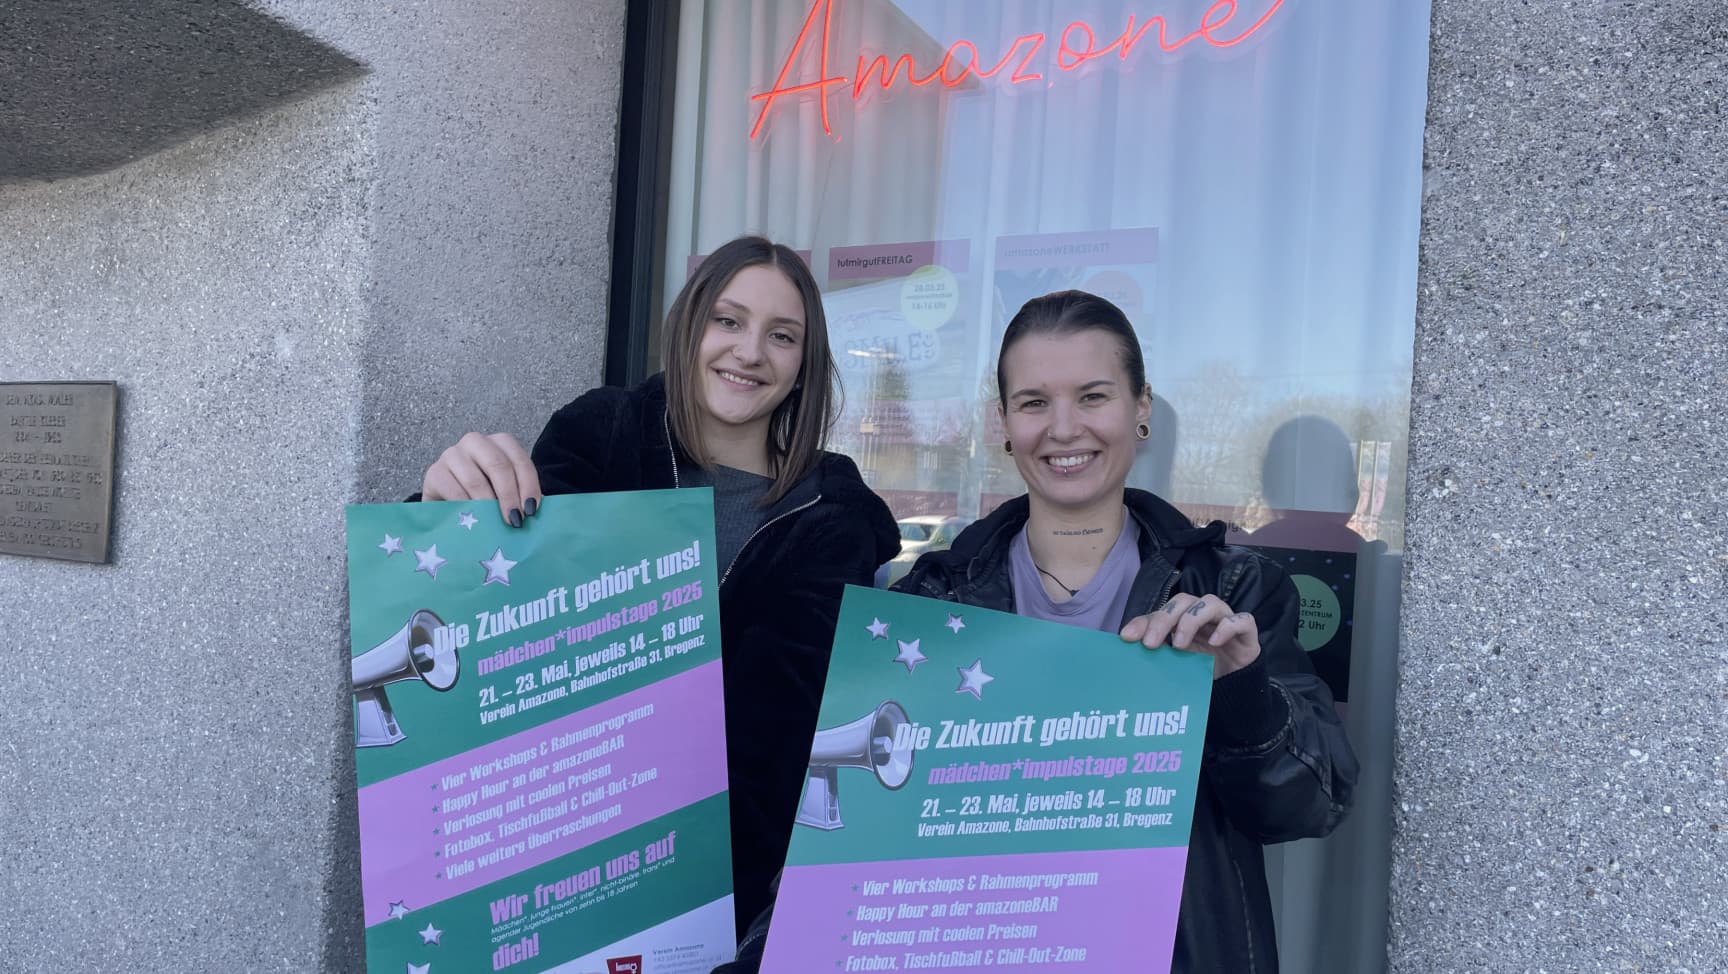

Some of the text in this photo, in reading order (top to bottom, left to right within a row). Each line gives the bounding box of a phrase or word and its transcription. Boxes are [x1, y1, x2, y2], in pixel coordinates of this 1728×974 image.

[751, 0, 1284, 139] Amazone
[433, 540, 700, 655] Die Zukunft gehört uns!
[662, 580, 703, 612] 2025
[1308, 620, 1326, 630] Uhr
[479, 685, 499, 707] 21.
[516, 672, 539, 695] 23.
[541, 660, 572, 686] Mai,
[574, 642, 626, 677] jeweils
[629, 632, 646, 654] 14
[661, 622, 676, 642] 18
[678, 614, 704, 635] Uhr
[479, 635, 705, 725] Verein Amazone, Bahnhofstraße 31, Bregenz
[441, 703, 654, 791] Vier Workshops & Rahmenprogramm
[893, 705, 1189, 750] Die Zukunft gehört uns!
[442, 734, 625, 814] Happy Hour an der amazoneBAR
[1132, 750, 1183, 774] 2025
[443, 763, 612, 835] Verlosung mit coolen Preisen
[444, 767, 658, 859] Fotobox, Tischfußball & Chill-Out-Zone
[920, 798, 940, 818] 21.
[960, 796, 983, 815] 23.
[987, 794, 1020, 815] Mai,
[1022, 791, 1083, 815] jeweils
[1087, 789, 1105, 809] 14
[1125, 787, 1143, 807] 18
[1145, 786, 1177, 806] Uhr
[446, 804, 622, 880] Viele weitere Überraschungen
[918, 812, 1173, 837] Verein Amazone, Bahnhofstraße 31, Bregenz
[489, 831, 676, 926] Wir freuen uns auf
[662, 856, 675, 866] und
[862, 872, 1098, 897] Vier Workshops & Rahmenprogramm
[491, 928, 520, 943] agender
[565, 906, 578, 915] von
[616, 881, 638, 895] Jahren
[856, 896, 1059, 922] Happy Hour an der amazoneBAR
[493, 932, 539, 971] dich!
[852, 923, 1037, 946] Verlosung mit coolen Preisen
[845, 946, 1087, 972] Fotobox, Tischfußball & Chill-Out-Zone
